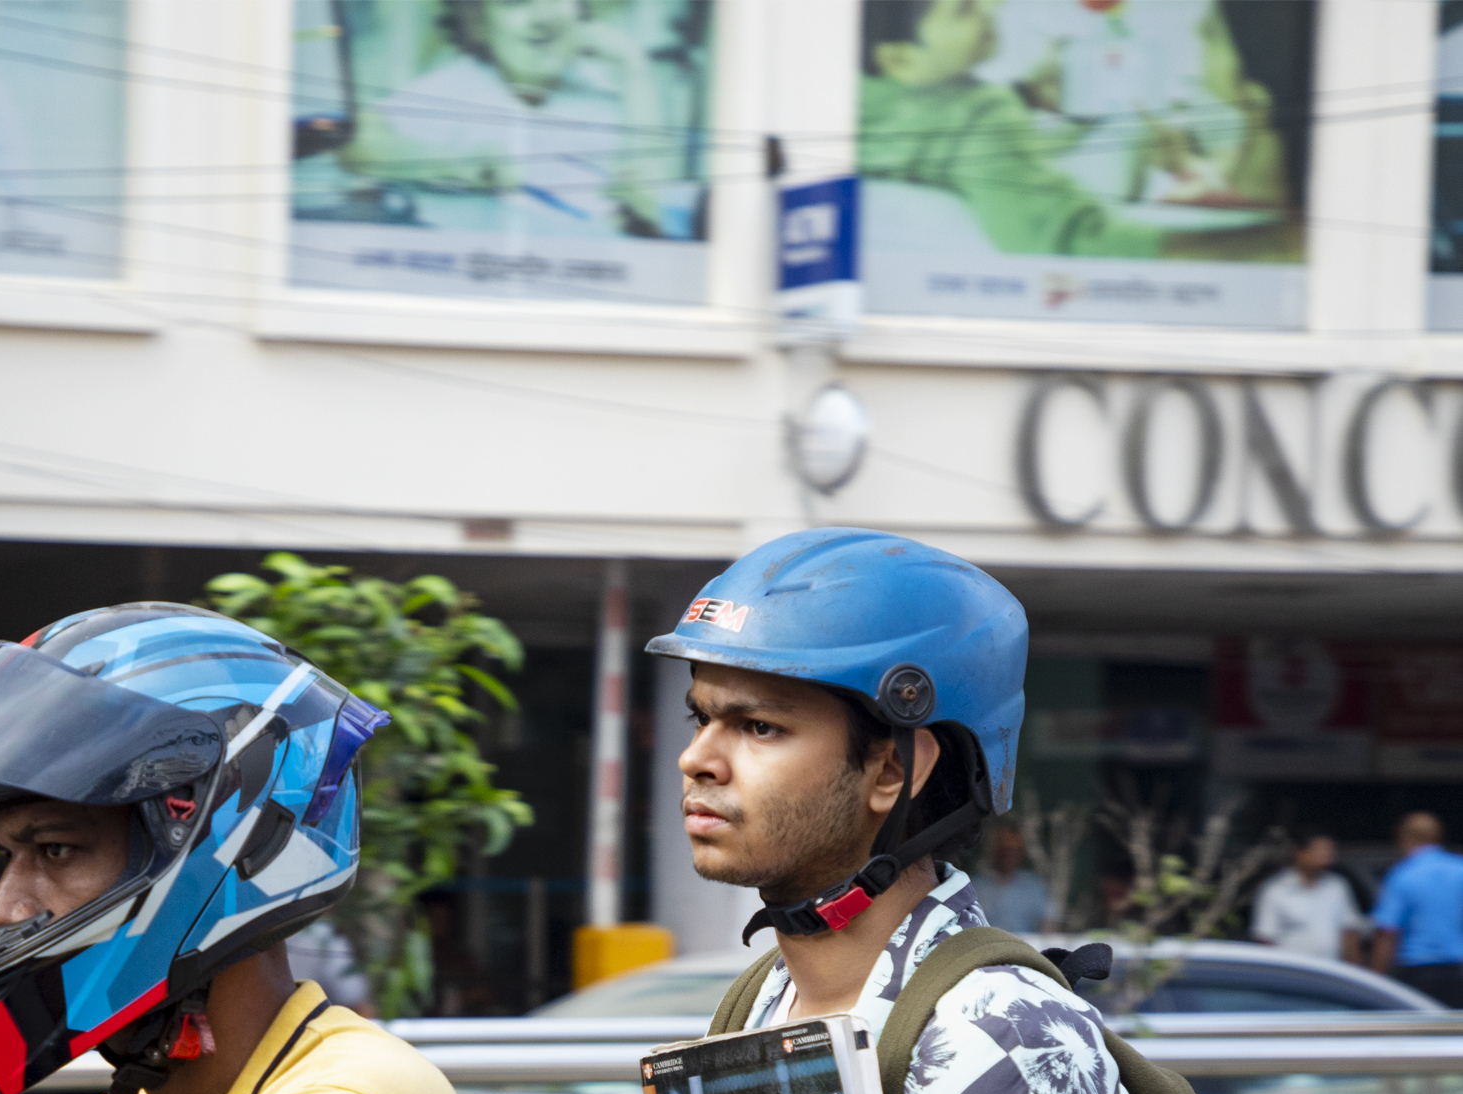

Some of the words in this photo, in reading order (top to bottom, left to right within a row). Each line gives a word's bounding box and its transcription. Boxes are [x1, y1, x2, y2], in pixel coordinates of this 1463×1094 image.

[1012, 375, 1463, 536] CONC
[792, 1032, 831, 1046] CAMBRIDGE
[652, 1057, 684, 1070] CAMBRIDGE
